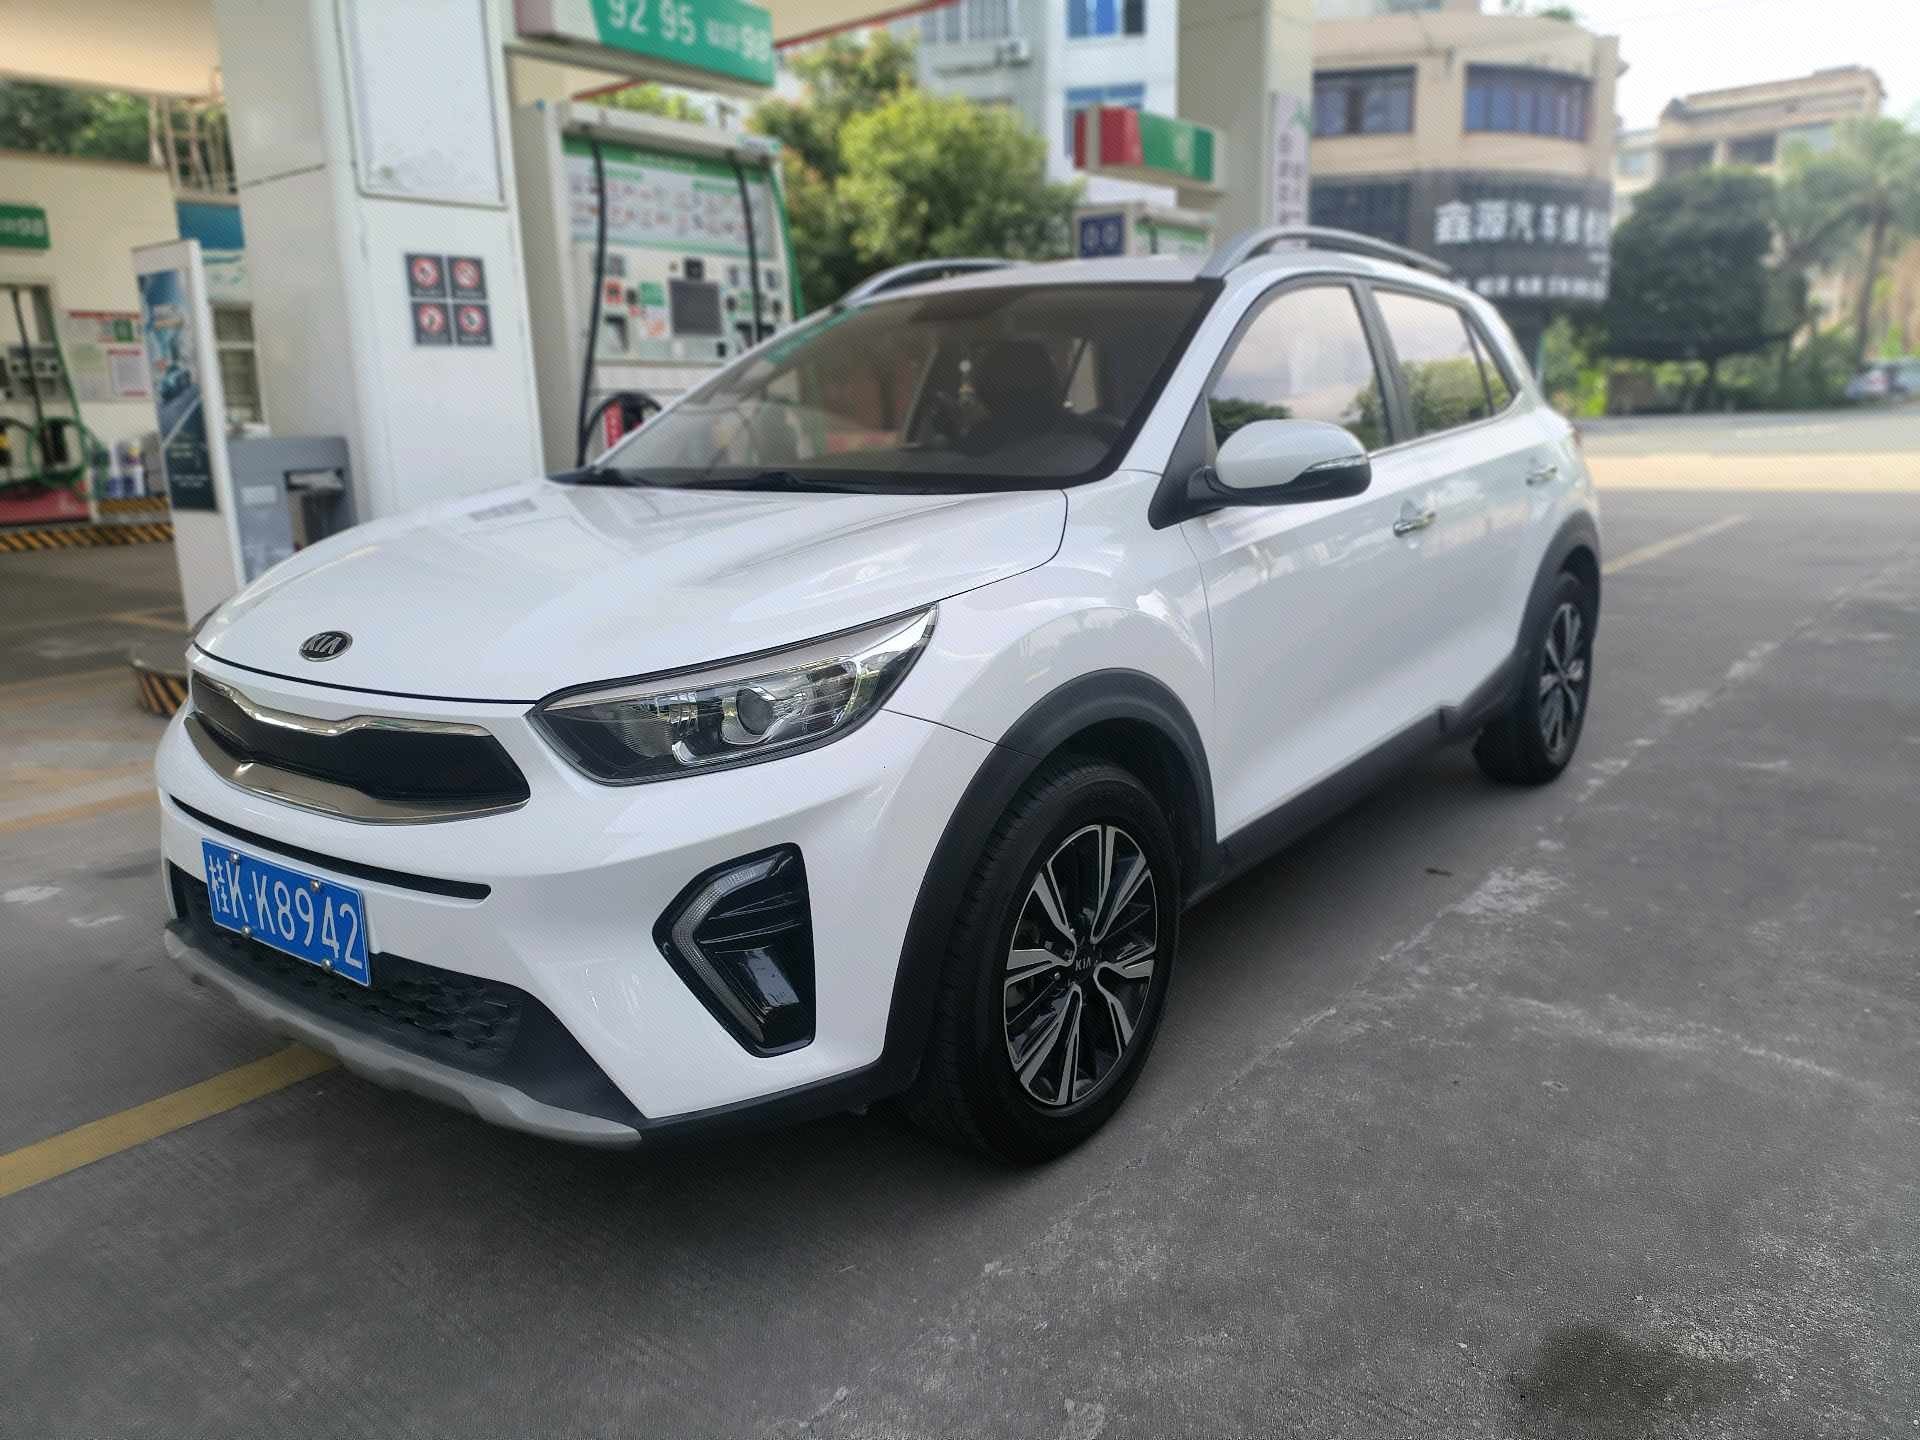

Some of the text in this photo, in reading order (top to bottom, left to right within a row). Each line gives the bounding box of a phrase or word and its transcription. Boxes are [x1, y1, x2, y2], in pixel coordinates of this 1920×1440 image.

[608, 0, 647, 33] 92
[659, 0, 696, 45] 95
[1075, 956, 1091, 971] KIA
